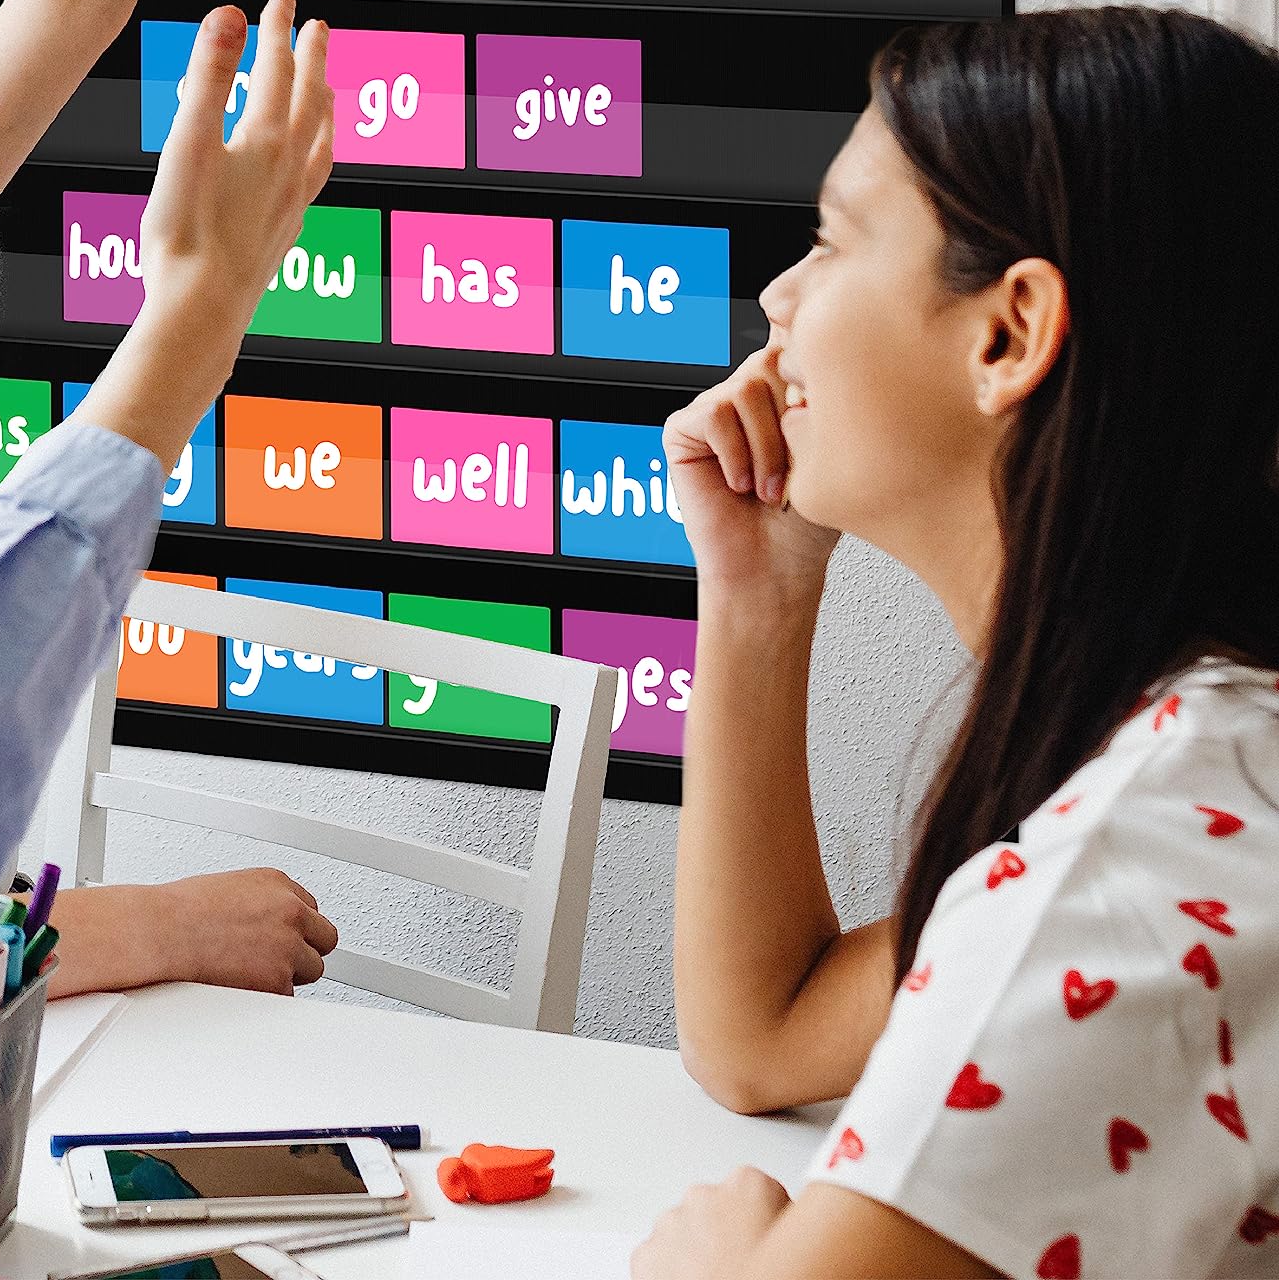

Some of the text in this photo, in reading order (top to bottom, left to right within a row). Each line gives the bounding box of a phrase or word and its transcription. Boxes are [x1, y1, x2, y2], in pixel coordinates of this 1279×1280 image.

[355, 73, 612, 140] go give
[267, 246, 356, 299] ow
[422, 244, 519, 308] has
[610, 254, 680, 315] he
[264, 441, 341, 490] we
[413, 442, 529, 508] well
[562, 456, 685, 524] whi
[118, 617, 186, 673] ou
